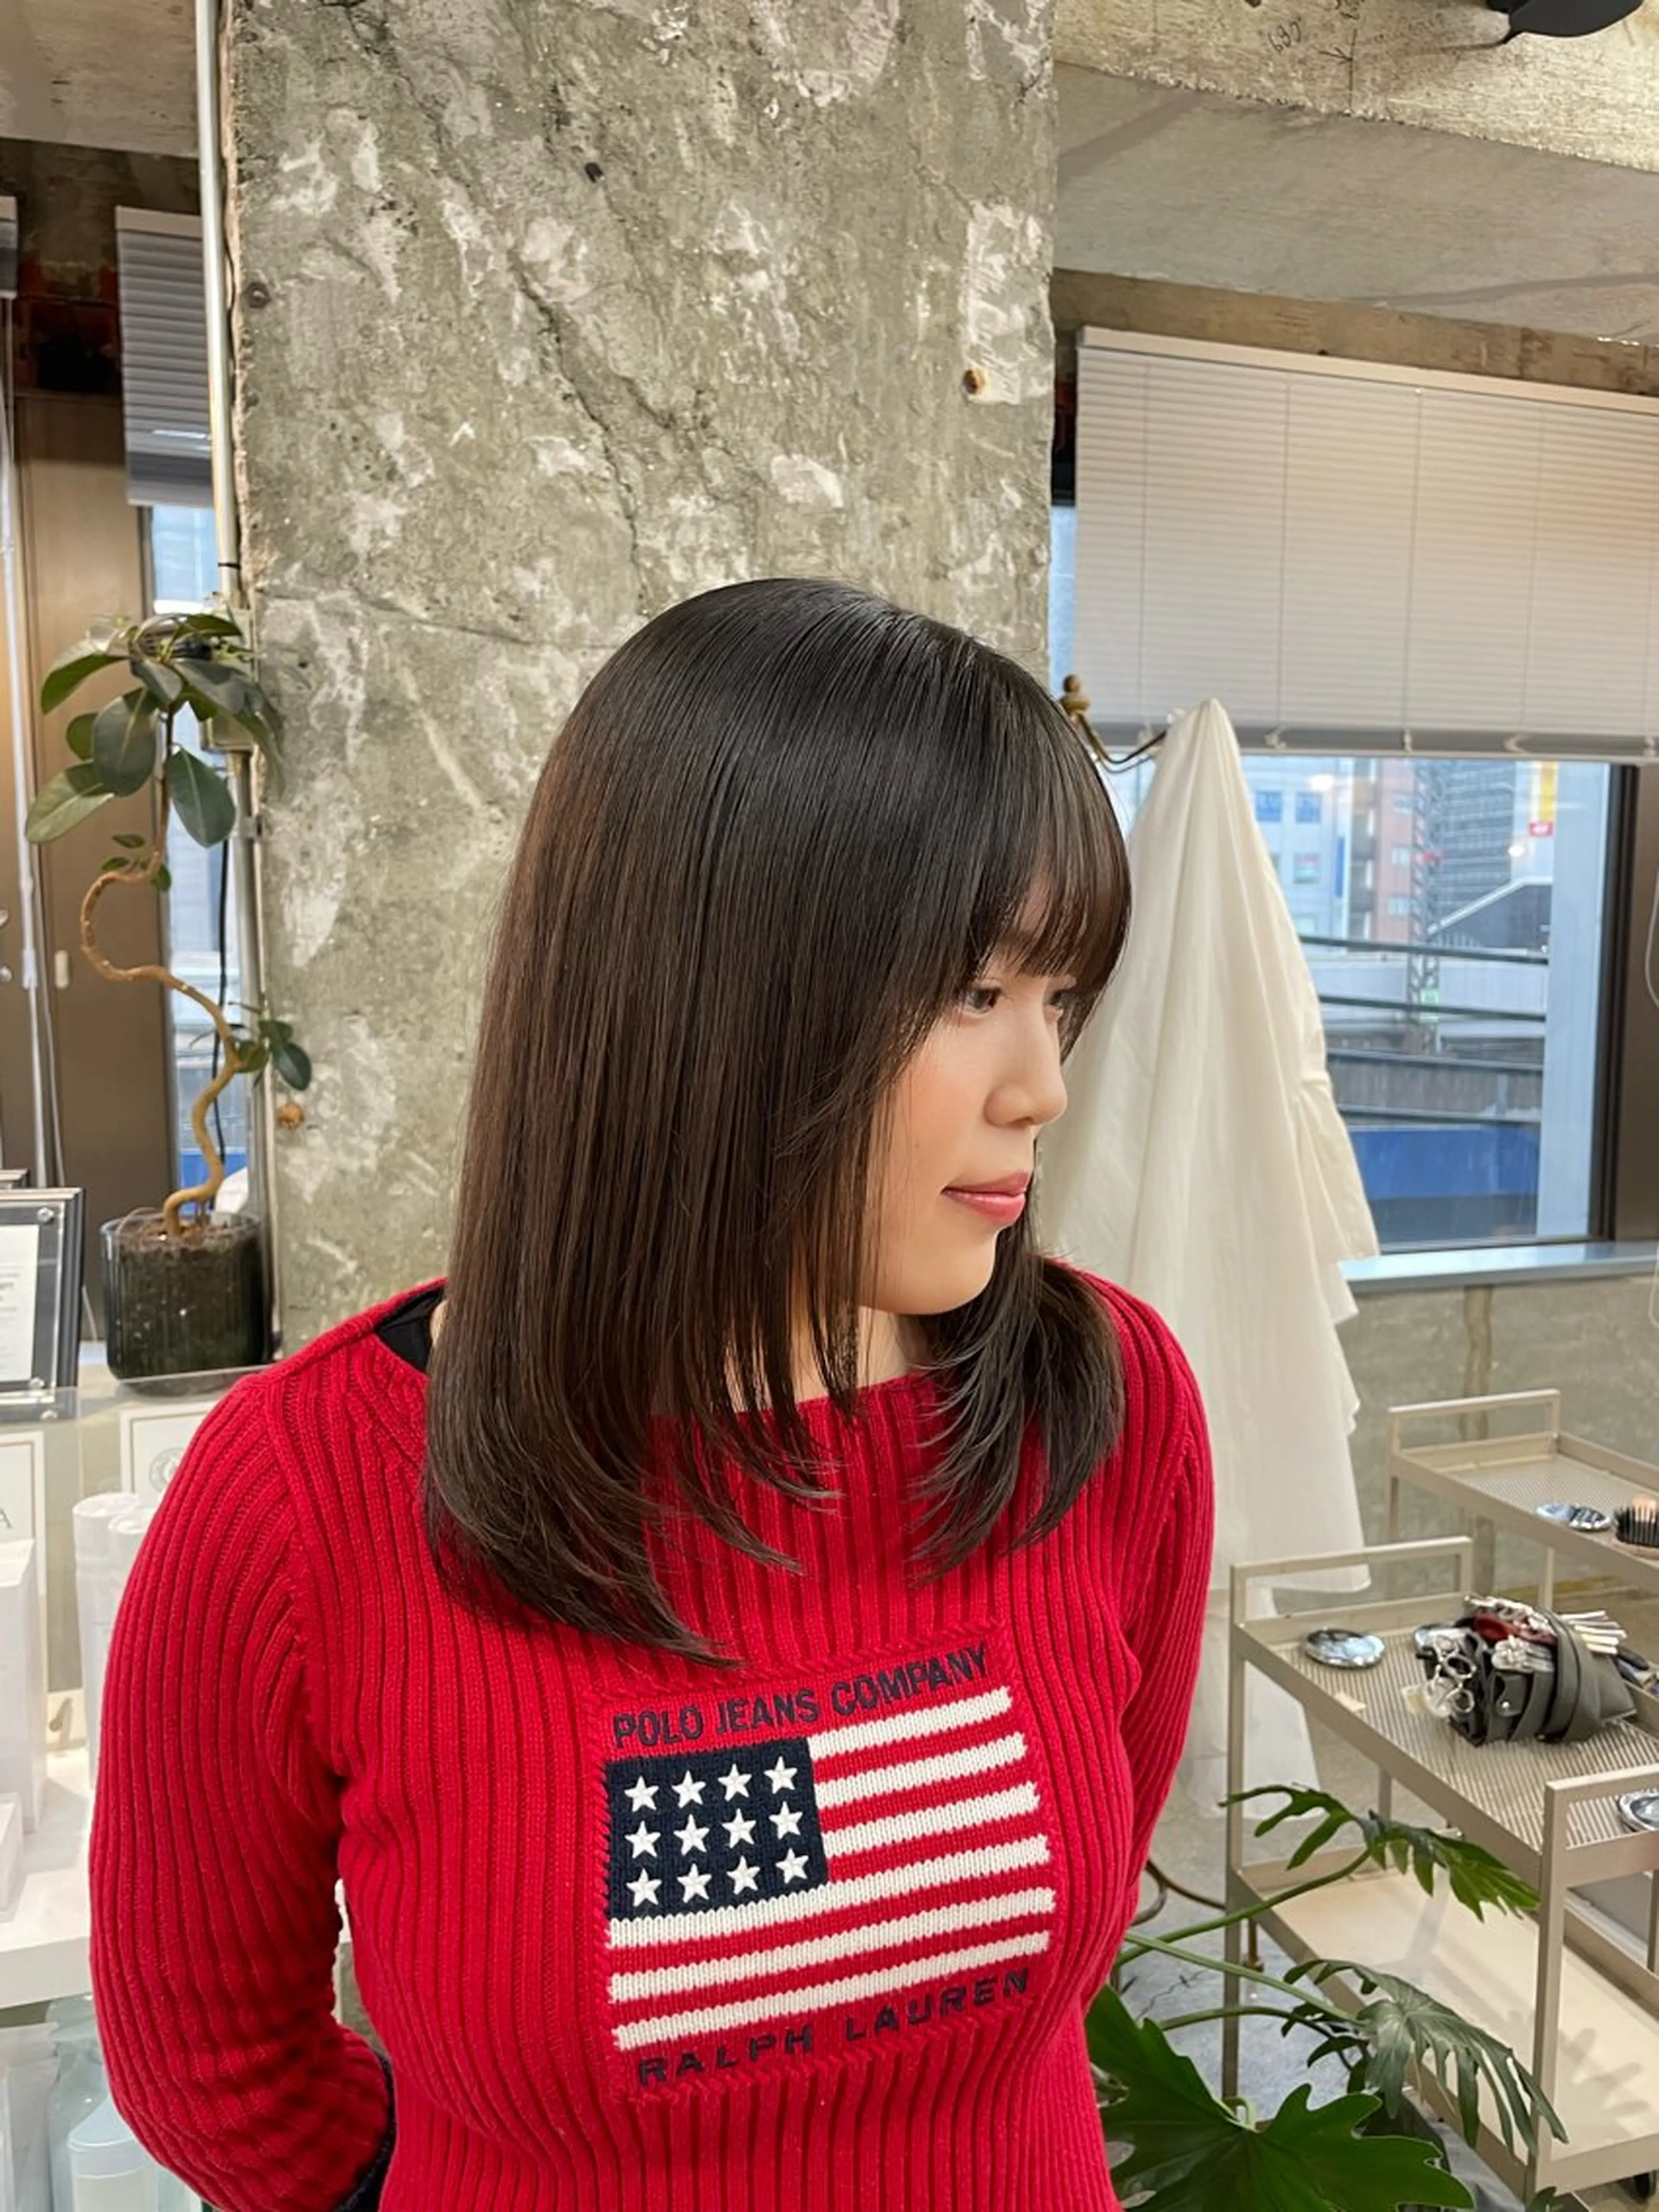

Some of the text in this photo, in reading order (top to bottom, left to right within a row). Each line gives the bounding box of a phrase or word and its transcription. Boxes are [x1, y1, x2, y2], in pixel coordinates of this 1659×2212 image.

[613, 1640, 987, 1749] POLO JEANS COMPANY
[639, 1967, 1029, 2085] RALPH LAUREN
